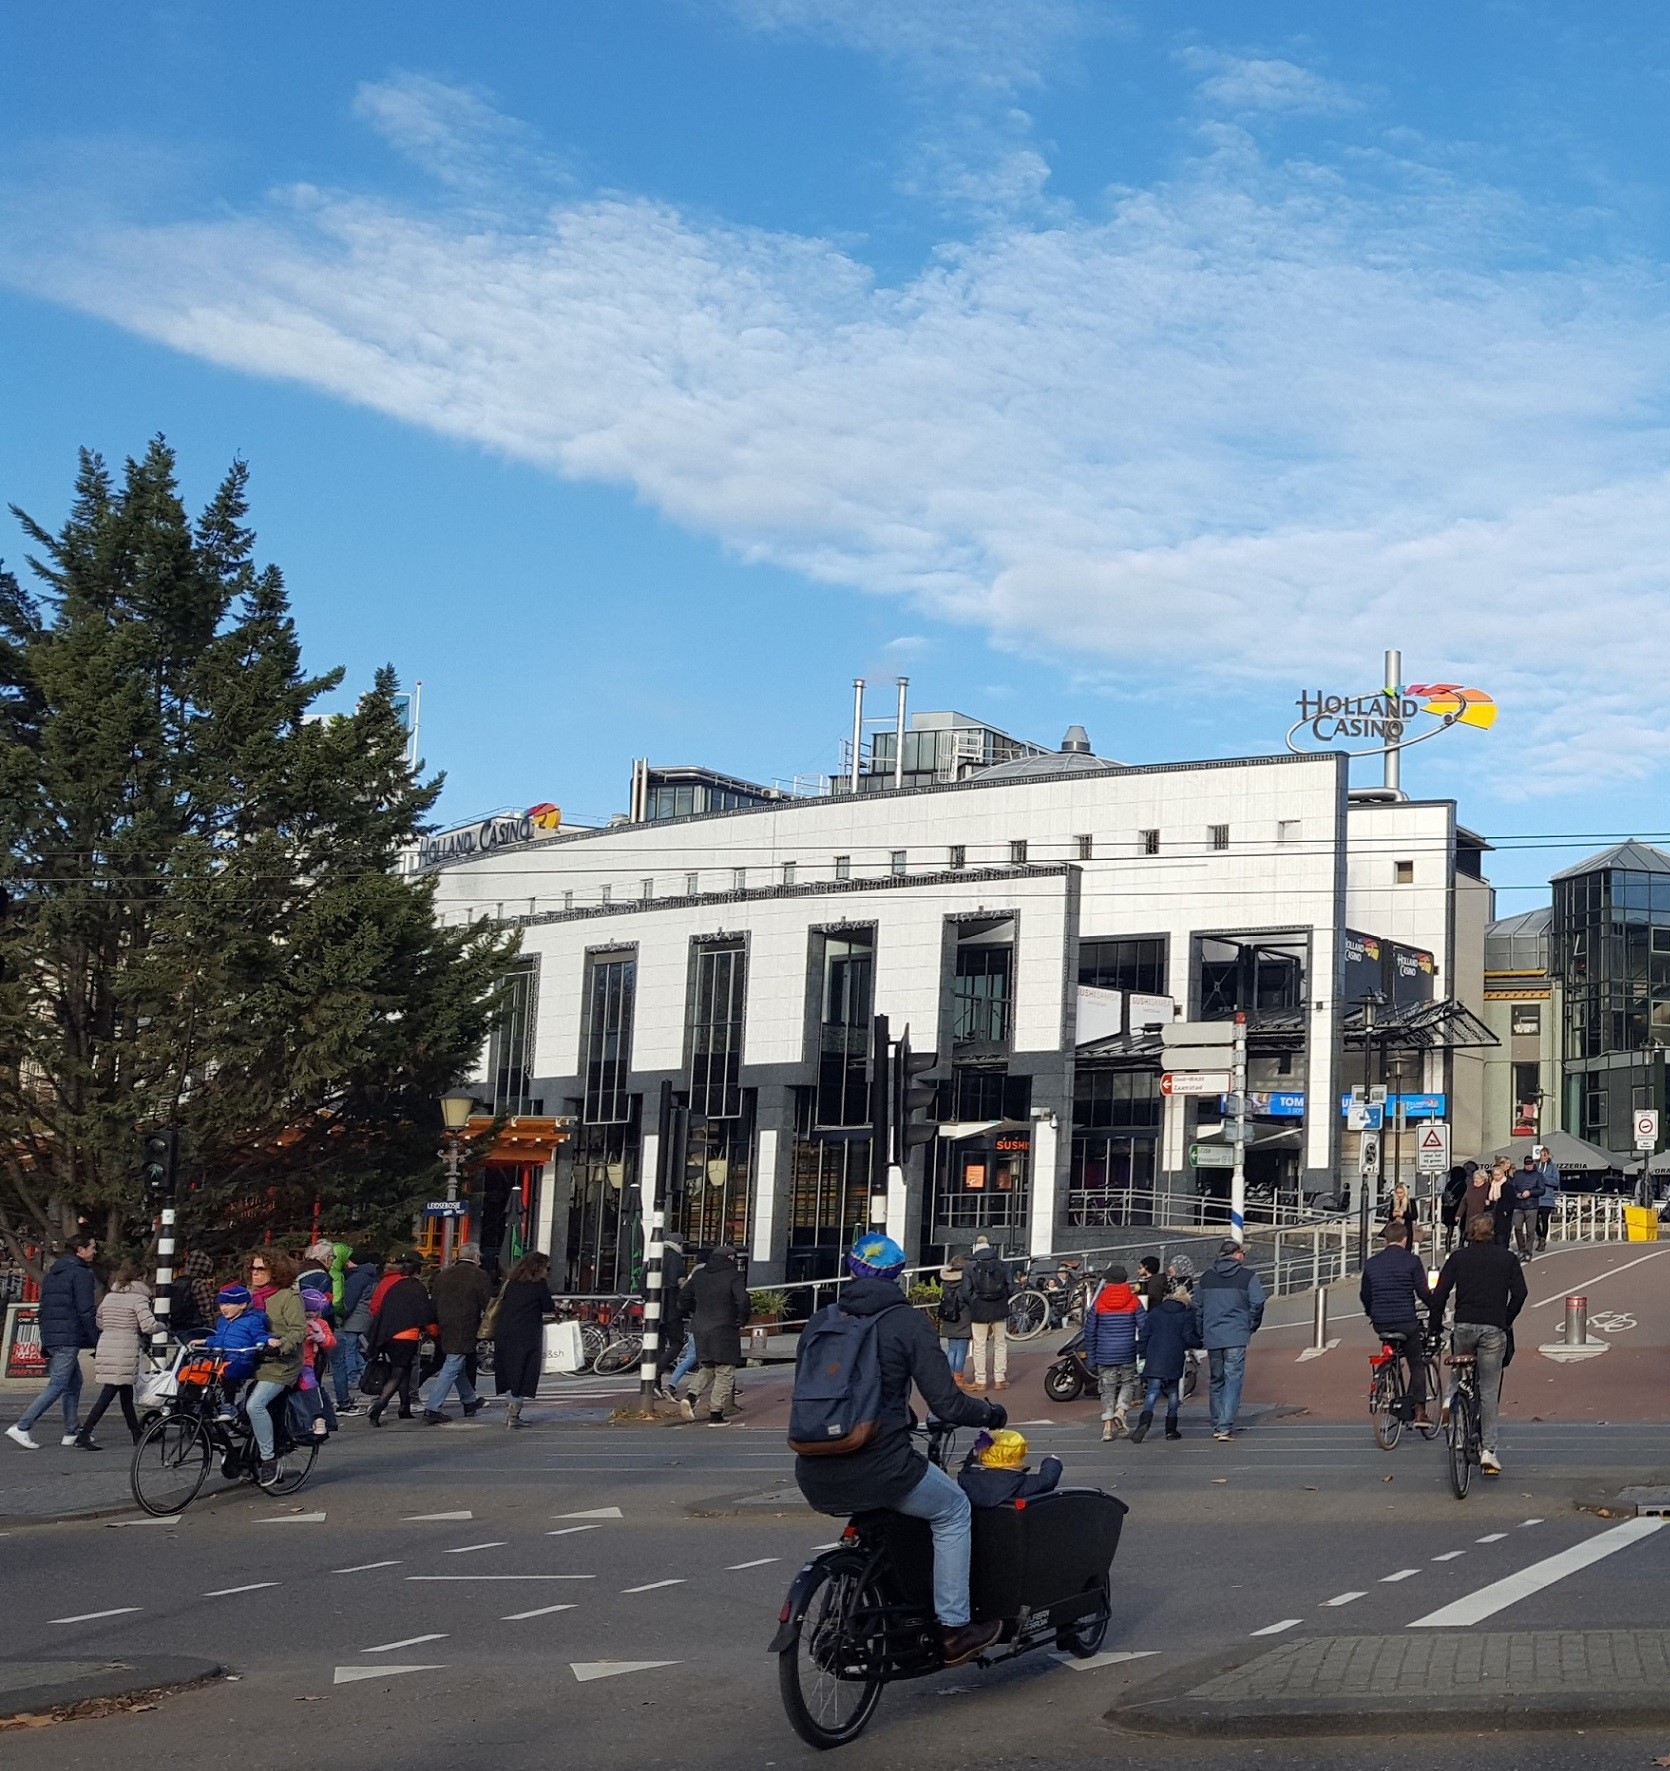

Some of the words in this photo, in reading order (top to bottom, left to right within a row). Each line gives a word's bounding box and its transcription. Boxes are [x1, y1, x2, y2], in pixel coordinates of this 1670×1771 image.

[1295, 689, 1419, 720] HOLLAND
[1312, 715, 1405, 741] CASINO
[419, 831, 476, 869] HOLLAND
[480, 818, 535, 850] CASINO
[1396, 953, 1418, 969] HOLLAND
